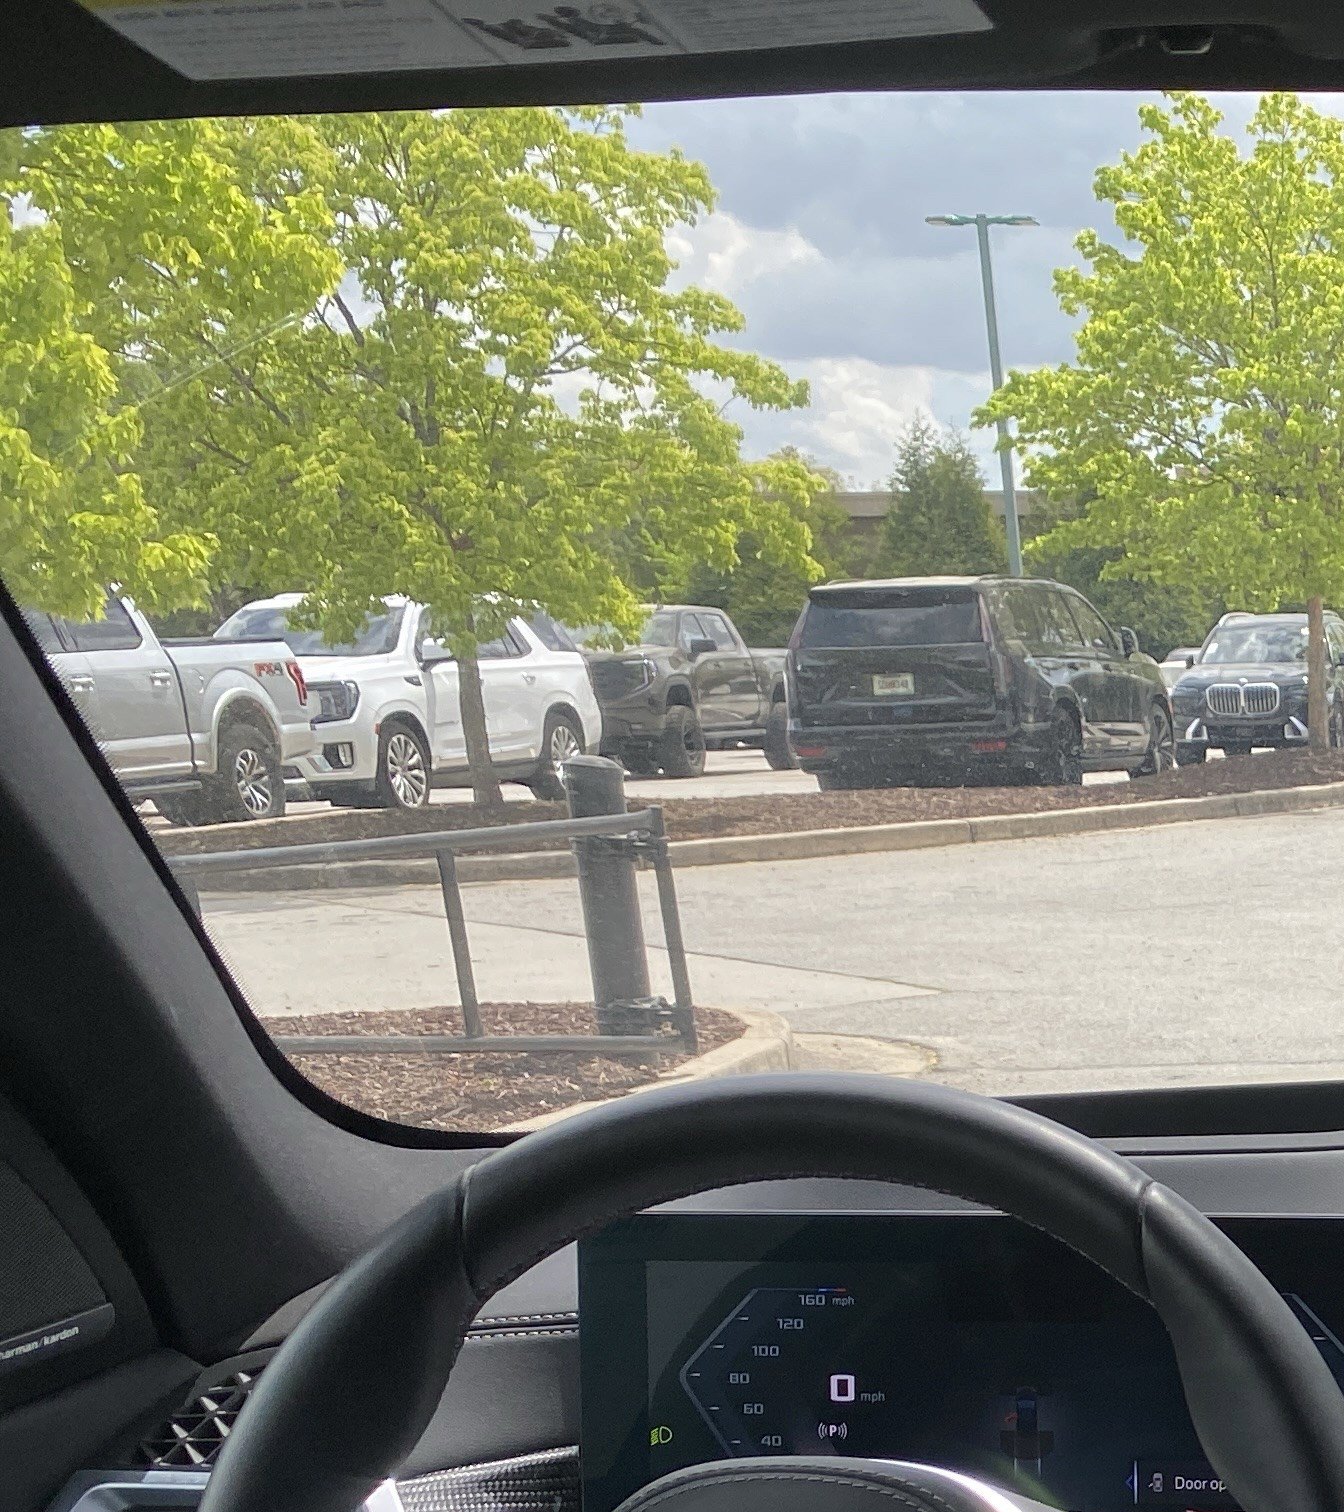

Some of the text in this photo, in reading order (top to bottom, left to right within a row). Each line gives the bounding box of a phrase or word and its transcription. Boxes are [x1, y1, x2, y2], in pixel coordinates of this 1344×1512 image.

[799, 1294, 855, 1307] 160 mph
[777, 1318, 804, 1330] 120
[752, 1345, 780, 1357] 100
[728, 1372, 750, 1384] 80
[830, 1373, 886, 1403] 0 mph
[743, 1403, 764, 1415] 60
[760, 1435, 782, 1446] 40
[1174, 1476, 1209, 1490] Door
